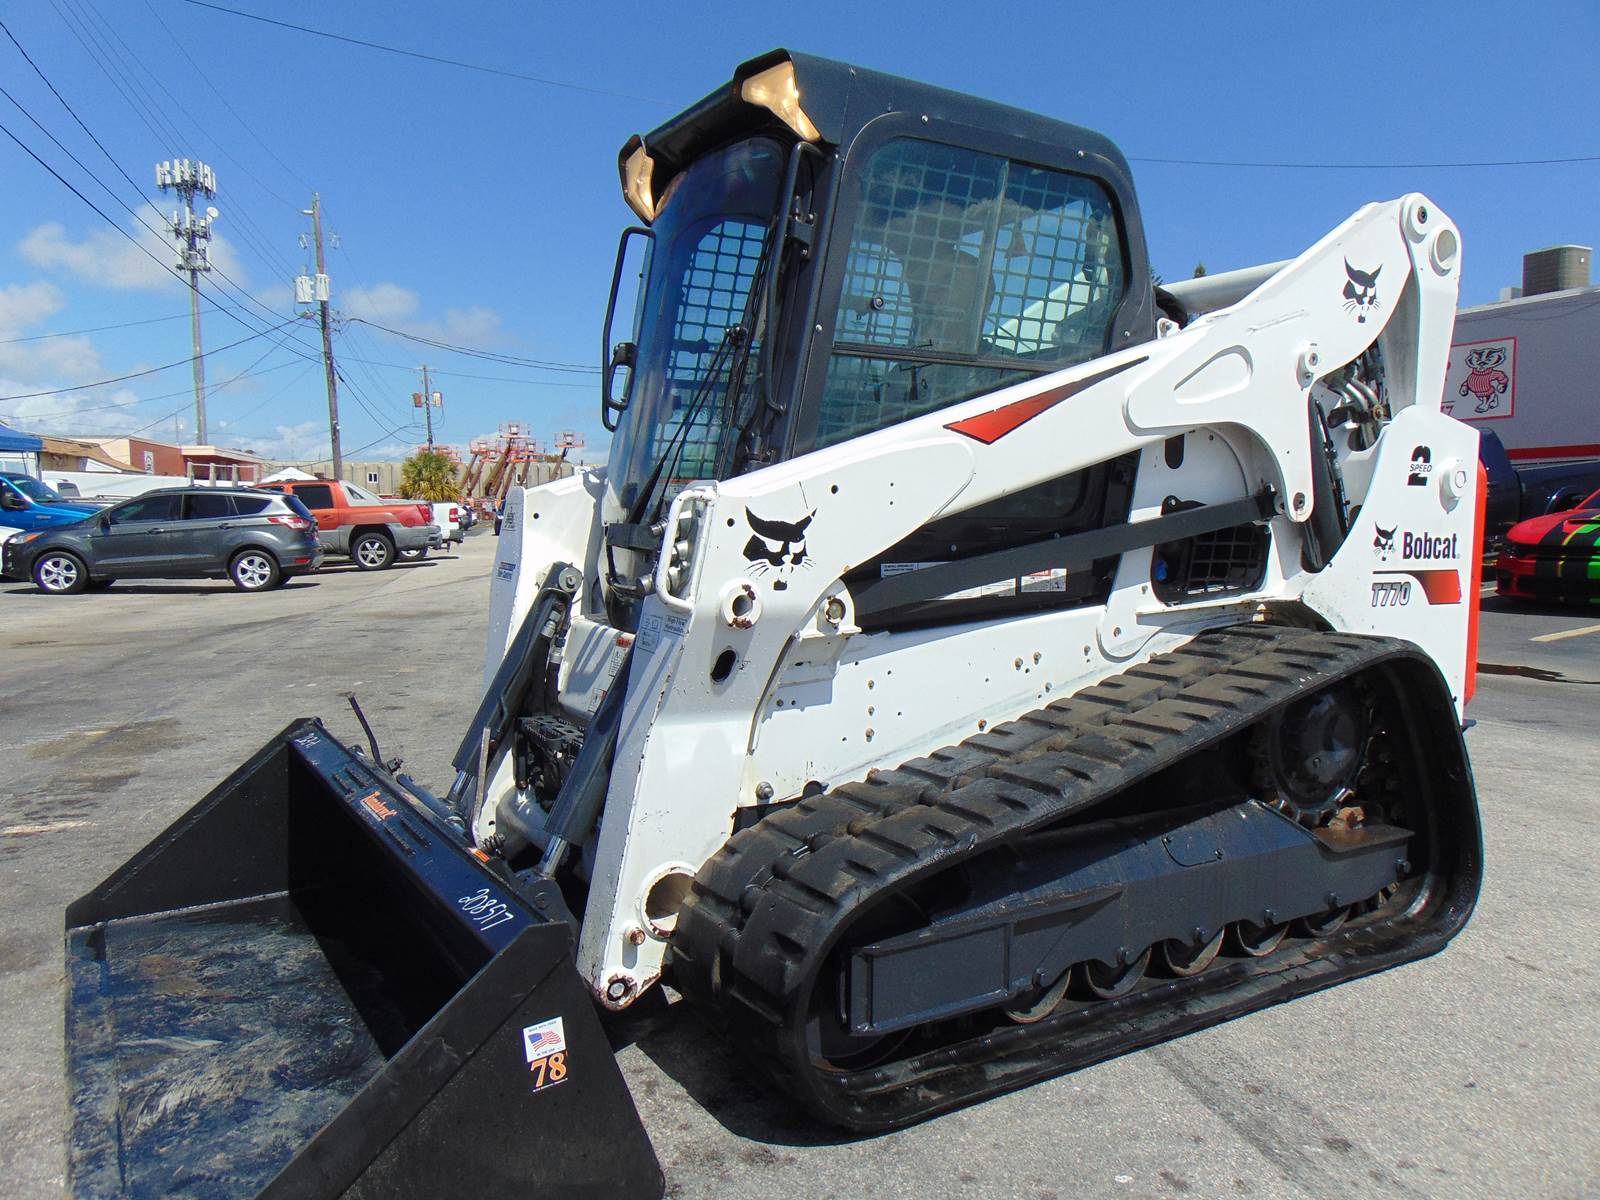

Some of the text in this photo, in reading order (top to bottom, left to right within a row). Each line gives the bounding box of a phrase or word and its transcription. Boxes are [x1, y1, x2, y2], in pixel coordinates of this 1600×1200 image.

[1409, 463, 1433, 473] SPEED
[1402, 531, 1457, 560] Bobcat
[1371, 581, 1412, 607] T770
